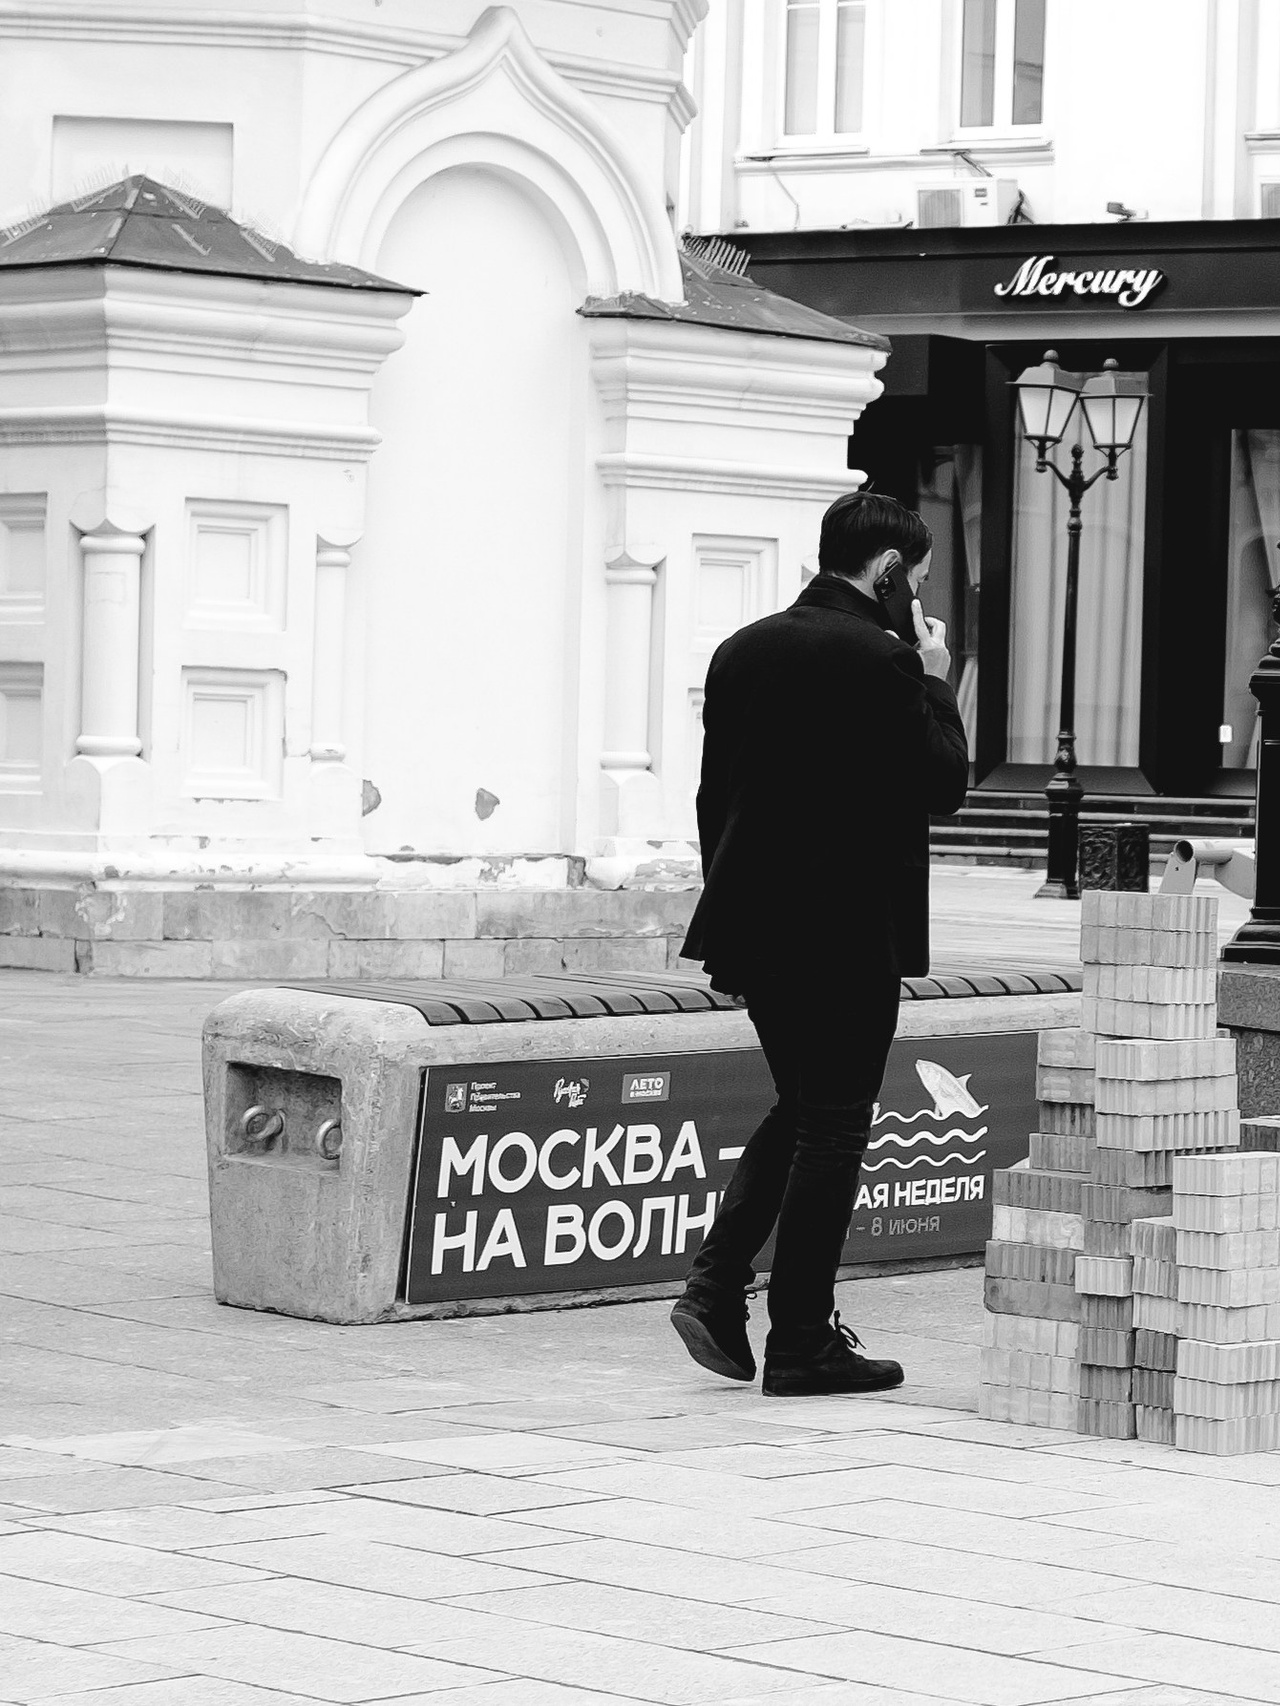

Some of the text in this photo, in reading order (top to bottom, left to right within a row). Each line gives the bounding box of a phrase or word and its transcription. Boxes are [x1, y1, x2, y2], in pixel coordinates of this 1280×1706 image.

[993, 256, 1163, 307] Mercury
[437, 1120, 706, 1198] МОСКВА
[894, 1175, 986, 1207] НЕДЕЛЯ
[431, 1190, 725, 1275] НА ВОЛН
[871, 1216, 883, 1236] 8
